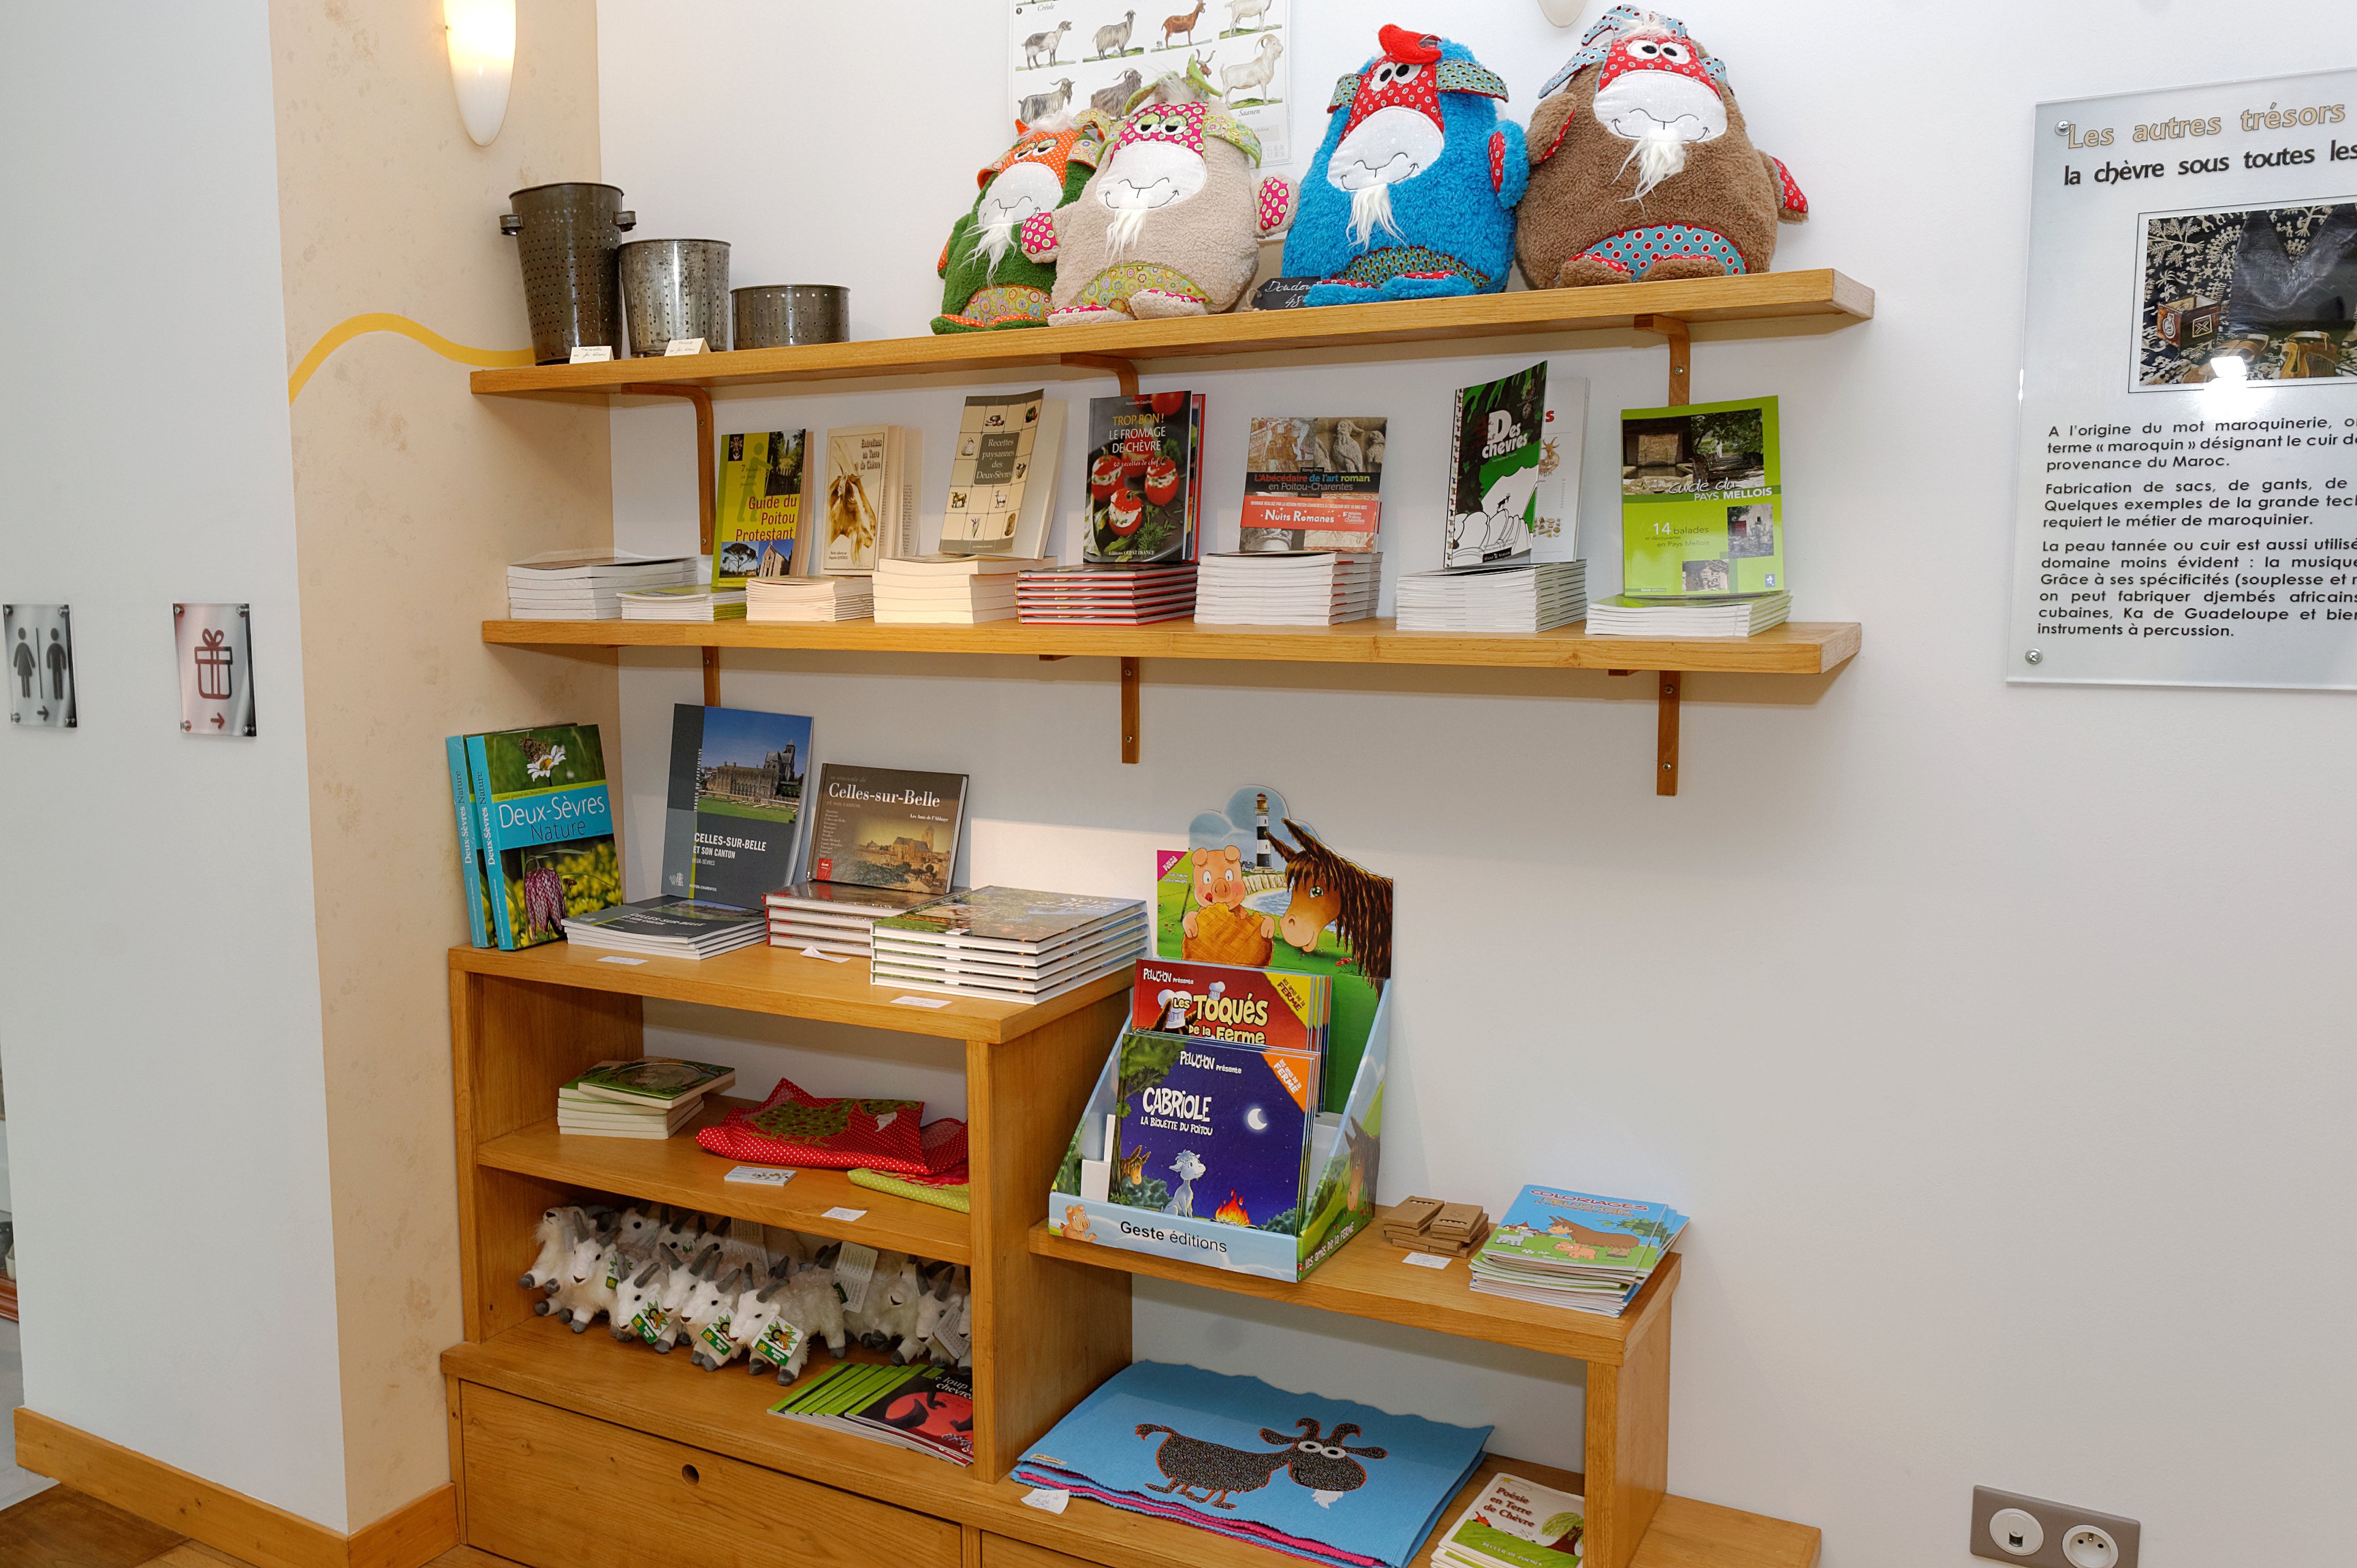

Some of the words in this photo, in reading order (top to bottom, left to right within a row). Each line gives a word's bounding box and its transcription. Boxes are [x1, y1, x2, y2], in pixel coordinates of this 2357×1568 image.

[2068, 124, 2113, 148] Les
[2133, 116, 2221, 142] autres
[2241, 103, 2345, 131] trésors
[2064, 165, 2081, 185] la
[2094, 159, 2164, 184] chèvre
[2179, 157, 2229, 175] sous
[2244, 146, 2315, 169] toutes
[1113, 415, 1137, 425] TROP
[1139, 413, 1159, 425] BON
[1487, 410, 1521, 445] Des
[2048, 426, 2059, 437] A
[2070, 423, 2132, 438] l'origine
[2142, 422, 2162, 434] du
[2172, 420, 2205, 433] mot
[2215, 415, 2332, 433] maroquinerie,
[1109, 430, 1118, 440] LE
[1120, 427, 1166, 439] FROMAGE
[1112, 443, 1124, 453] DE
[1126, 440, 1160, 453] CHÈVRE
[2047, 442, 2092, 454] terme
[2108, 438, 2183, 453] maroquin
[2200, 435, 2283, 451] désignant
[2286, 434, 2302, 447] le
[2306, 433, 2339, 446] cuir
[982, 451, 1014, 460] paysannes
[2046, 460, 2142, 473] provenance
[2147, 455, 2168, 468] du
[2172, 455, 2230, 468] Maroc.
[1254, 474, 1308, 482] L'Abécédaire
[1309, 474, 1320, 482] de
[1669, 479, 1709, 494] Guide
[1715, 477, 1735, 490] du
[2045, 481, 2132, 495] Fabrication
[2143, 481, 2164, 493] de
[2174, 483, 2216, 493] sacs,
[2228, 479, 2250, 491] de
[2262, 477, 2312, 494] gants,
[2325, 477, 2347, 490] de
[749, 496, 779, 509] Guide
[784, 494, 797, 507] du
[1694, 492, 1719, 501] PAYS
[1723, 487, 1772, 500] MELLOIS
[2044, 499, 2118, 513] Quelques
[2124, 497, 2202, 512] exemples
[2209, 496, 2231, 509] de
[2236, 496, 2251, 509] la
[2258, 495, 2320, 511] grande
[761, 512, 795, 525] Poitou
[1265, 509, 1291, 521] Nuits
[2042, 515, 2103, 530] requiert
[2106, 515, 2121, 527] le
[2125, 513, 2177, 527] métier
[2181, 514, 2202, 526] de
[2208, 513, 2313, 528] maroquinier.
[736, 528, 793, 542] Protestant
[1654, 522, 1671, 534] 14
[1673, 526, 1709, 534] balades
[2042, 541, 2059, 552] La
[2064, 543, 2105, 555] peau
[2110, 538, 2168, 551] tannée
[2173, 542, 2194, 551] ou
[2200, 539, 2231, 551] cuir
[2236, 539, 2261, 551] est
[2266, 538, 2308, 551] aussi
[2041, 556, 2110, 569] domaine
[2120, 556, 2167, 569] moins
[2177, 555, 2240, 569] évident
[2264, 556, 2280, 568] la
[2040, 573, 2089, 586] Grâce
[2094, 572, 2104, 586] à
[2109, 576, 2134, 586] ses
[2139, 572, 2230, 588] spécificités
[2235, 573, 2324, 588] (souplesse
[2330, 573, 2347, 586] et
[2039, 592, 2059, 602] on
[2071, 590, 2106, 605] peut
[2118, 590, 2191, 605] fabriquer
[2203, 589, 2276, 605] djembés
[2038, 606, 2113, 620] cubaines,
[2123, 607, 2144, 619] Ka
[2153, 607, 2174, 619] de
[2184, 607, 2290, 623] Guadeloupe
[2299, 608, 2317, 620] et
[2038, 622, 2123, 635] instruments
[2127, 622, 2138, 635] à
[2143, 624, 2234, 638] percussion.
[456, 771, 464, 803] Nature
[478, 772, 486, 804] Nature
[829, 782, 940, 807] Celles-sur-Belle
[499, 796, 605, 828] Deux-Sèvres
[460, 806, 471, 864] Deux-Sèvres
[482, 807, 495, 865] Deux-Sèvres
[531, 820, 586, 842] Nature
[695, 833, 767, 852] CELLES-SUR-BELLE
[693, 846, 701, 854] ET
[701, 847, 713, 856] SON
[714, 848, 735, 859] CANTON
[1277, 982, 1303, 1011] FERME
[1202, 1026, 1211, 1036] la
[1216, 1026, 1265, 1045] Ferme
[1216, 1065, 1242, 1074] présente
[1274, 1063, 1299, 1093] FERME
[1143, 1087, 1212, 1122] CABRIOLE
[1140, 1117, 1148, 1125] LA
[1531, 1189, 1649, 1211] COLORIAGES
[1120, 1220, 1165, 1241] Geste
[1169, 1230, 1227, 1253] éditions
[943, 1377, 968, 1389] loup
[1496, 1487, 1530, 1504] Poésie
[1490, 1497, 1503, 1505] en
[1506, 1501, 1533, 1516] Terre
[1483, 1504, 1497, 1513] de
[1499, 1510, 1536, 1527] Chèvre
